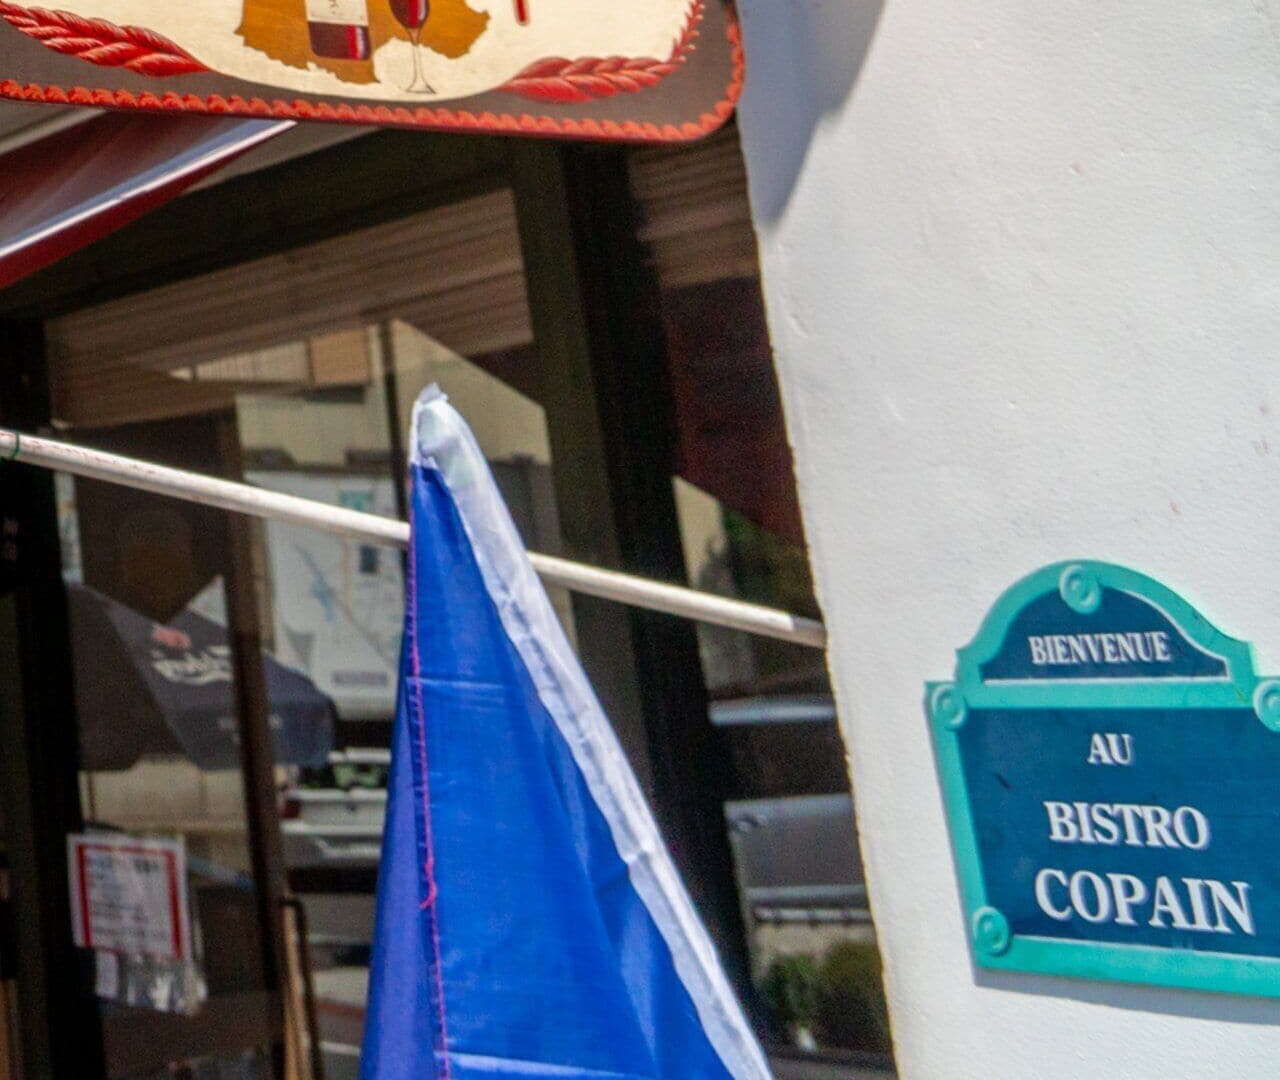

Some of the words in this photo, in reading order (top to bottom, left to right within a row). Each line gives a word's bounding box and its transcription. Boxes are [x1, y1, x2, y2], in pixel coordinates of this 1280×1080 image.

[1028, 631, 1171, 665] BIENVENUE
[1088, 733, 1134, 765] AU
[1044, 801, 1210, 850] BISTRO
[1035, 868, 1257, 935] COPAIN
